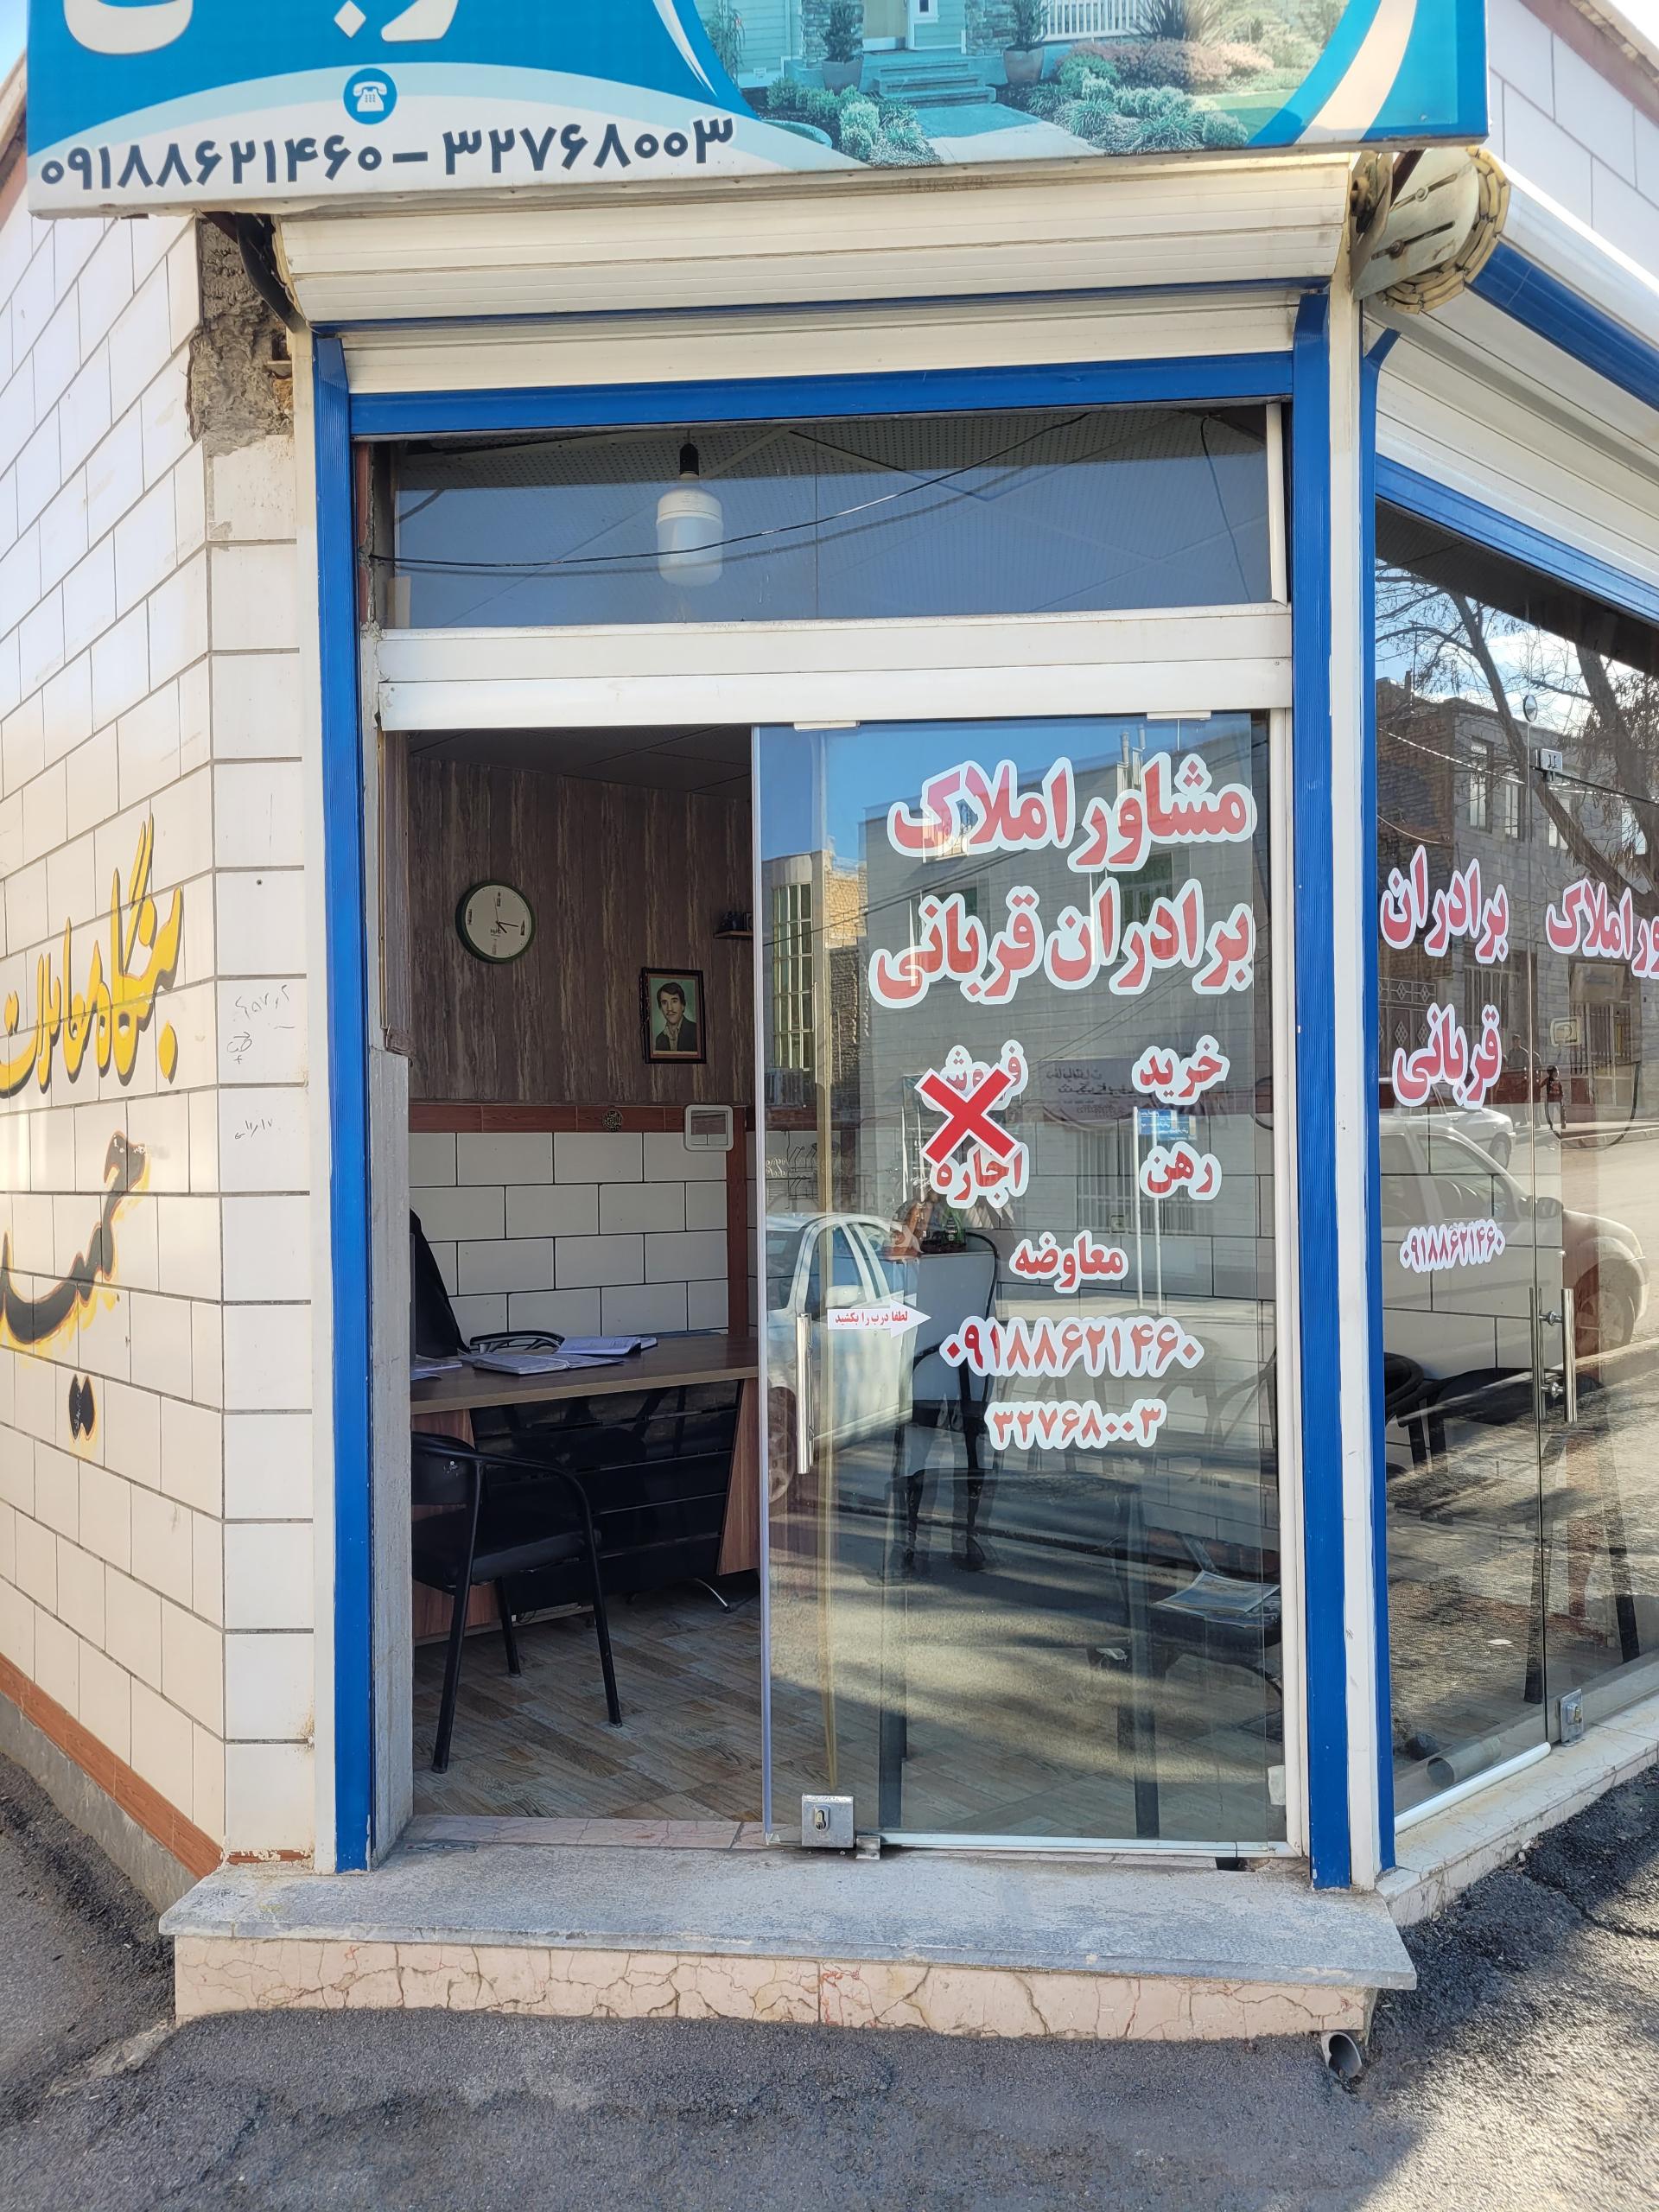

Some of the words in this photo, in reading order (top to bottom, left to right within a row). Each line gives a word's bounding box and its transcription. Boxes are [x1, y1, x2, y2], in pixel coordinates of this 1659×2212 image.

[890, 760, 1072, 854] املاک
[1071, 755, 1252, 869] مشاور
[1046, 880, 1253, 993] برادران
[1382, 847, 1507, 962] برادران
[1548, 880, 1631, 958] املاک
[872, 888, 1040, 1005] قربانی
[1135, 1038, 1227, 1103] خرید
[1394, 1004, 1500, 1107] قربانی
[931, 1143, 1027, 1207] اجاره
[1142, 1144, 1219, 1199] رهن
[1011, 1232, 1126, 1291] معاوضه
[835, 1312, 860, 1325] بکشید
[861, 1311, 870, 1326] را
[871, 1312, 889, 1325] درب
[891, 1310, 909, 1322] لطفا
[941, 1318, 1203, 1376] ۰۹۱۸۸۶۲۱۴۶۰
[987, 1400, 1165, 1448] ۳۲۷۶۸۰۰۳
